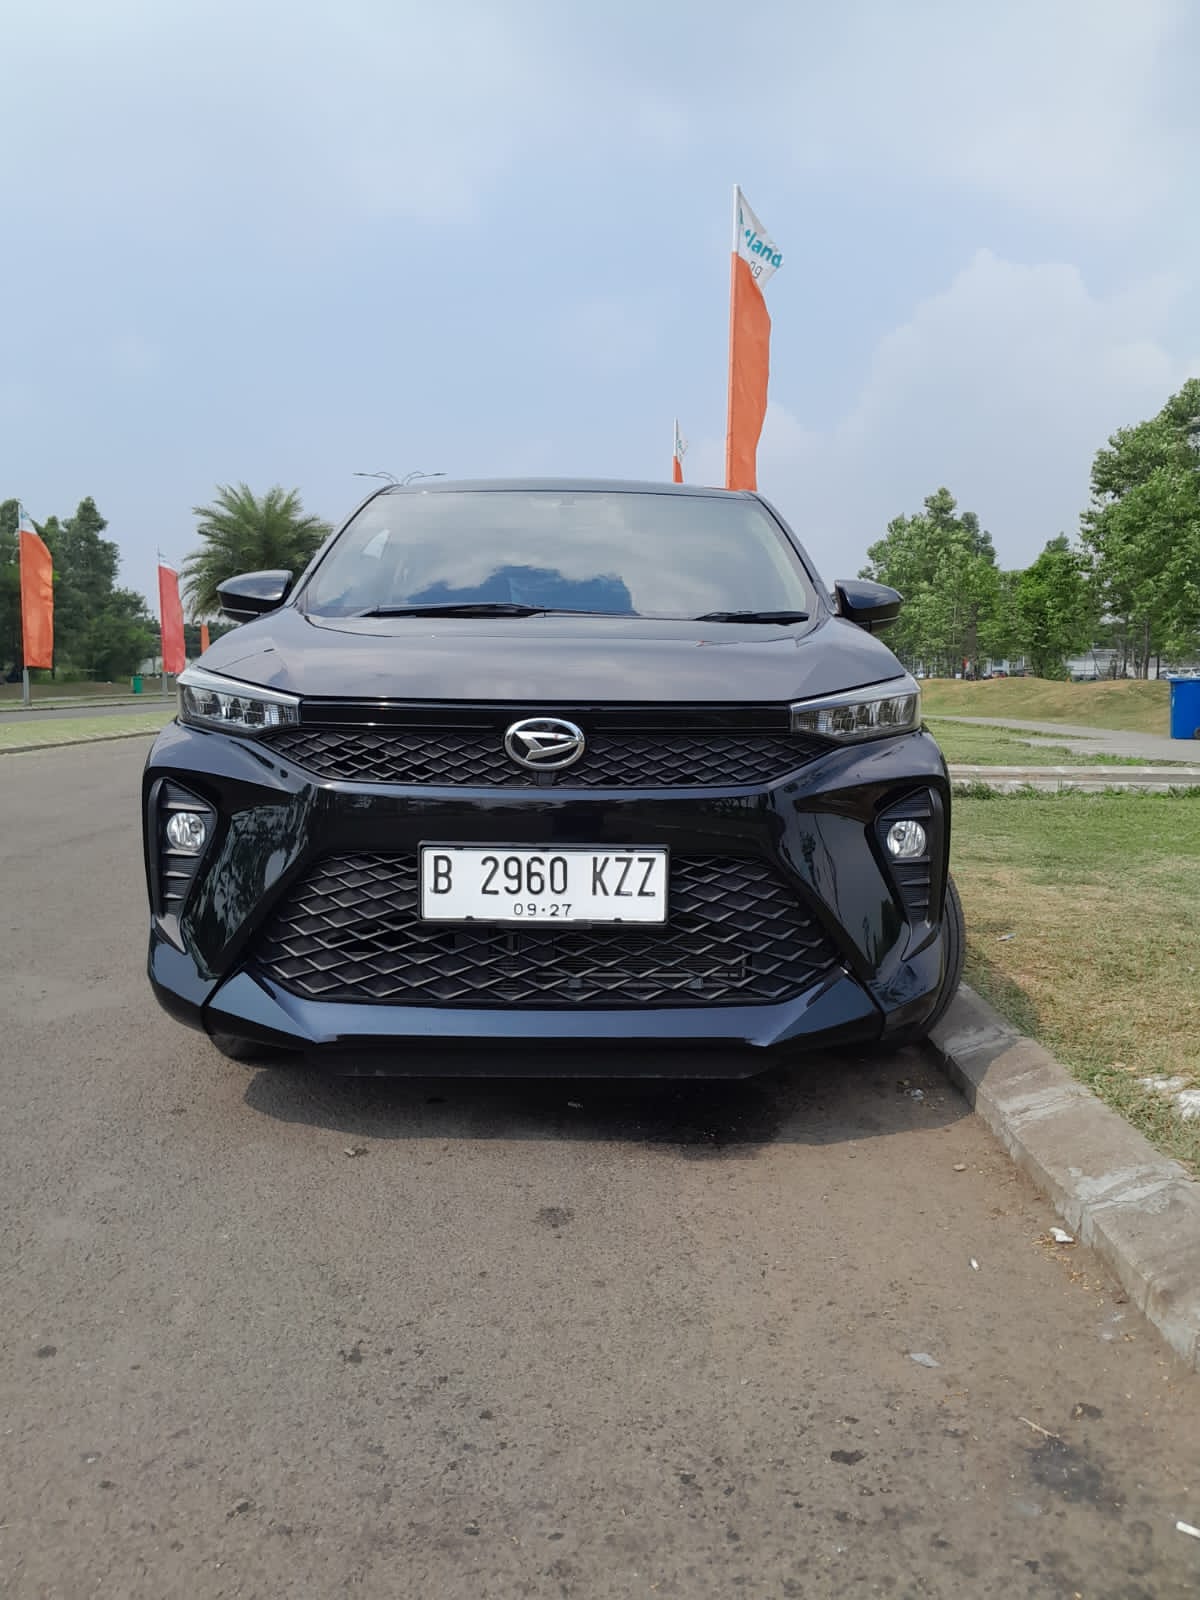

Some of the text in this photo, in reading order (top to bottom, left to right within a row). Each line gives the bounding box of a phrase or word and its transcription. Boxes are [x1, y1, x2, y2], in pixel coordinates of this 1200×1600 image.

[433, 855, 656, 896] B 2960 KZZ
